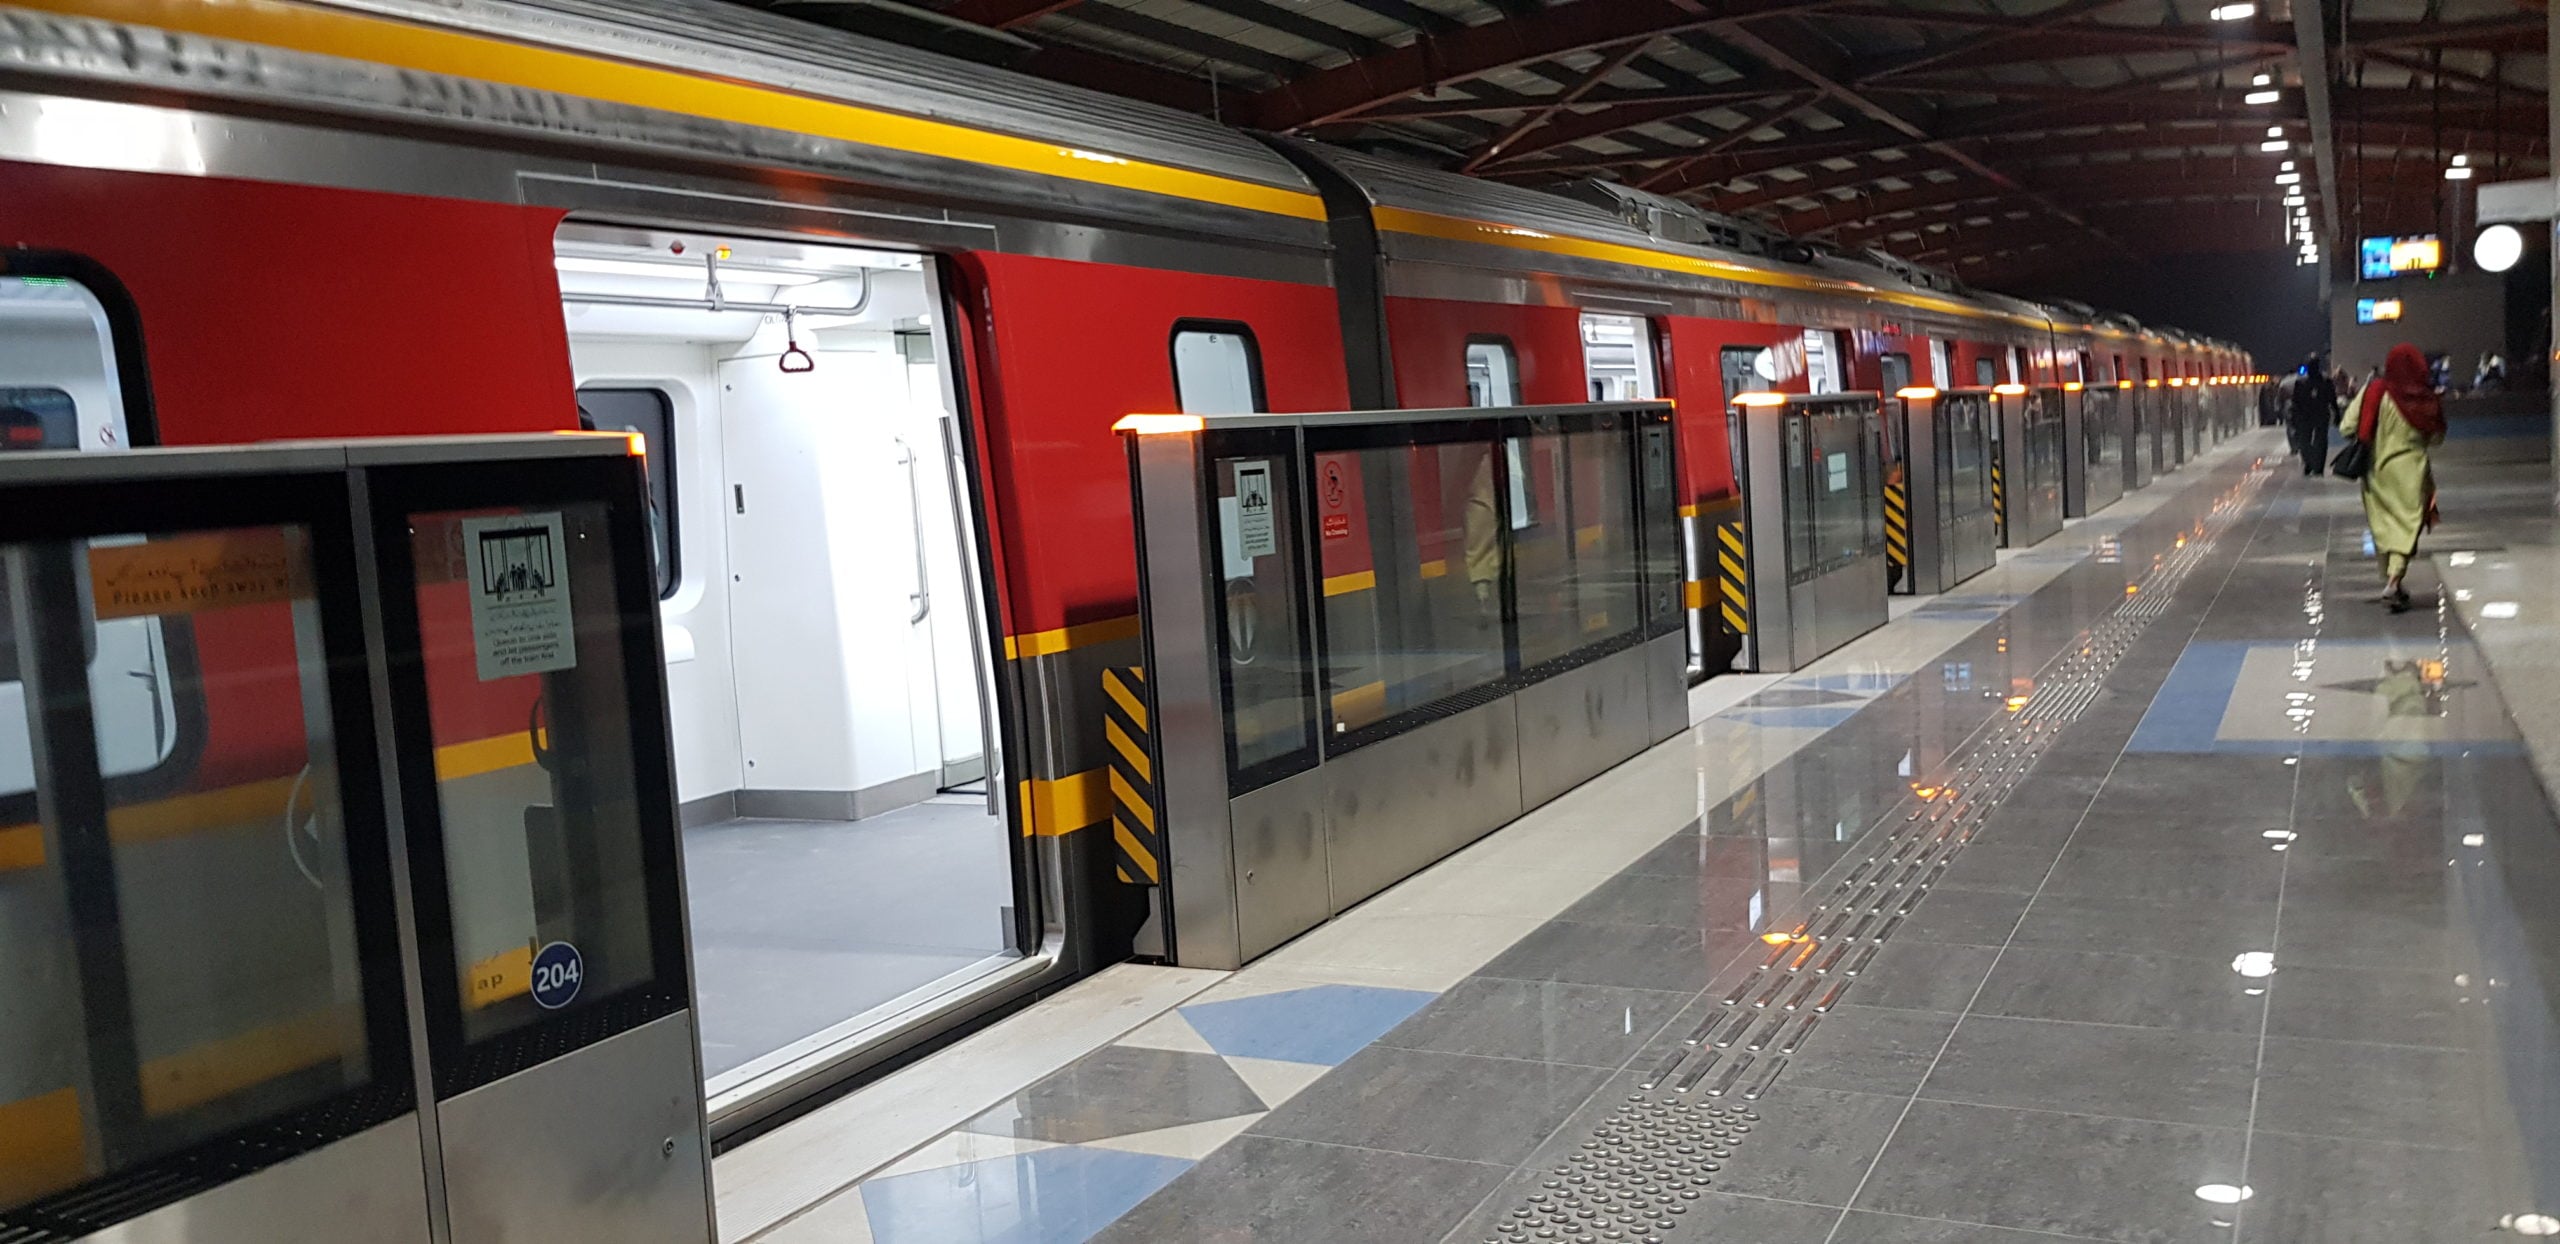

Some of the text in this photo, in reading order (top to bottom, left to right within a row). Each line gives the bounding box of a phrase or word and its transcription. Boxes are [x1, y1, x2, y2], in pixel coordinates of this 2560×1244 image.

[113, 590, 172, 605] Please
[180, 584, 219, 600] keep
[537, 958, 579, 992] 204
